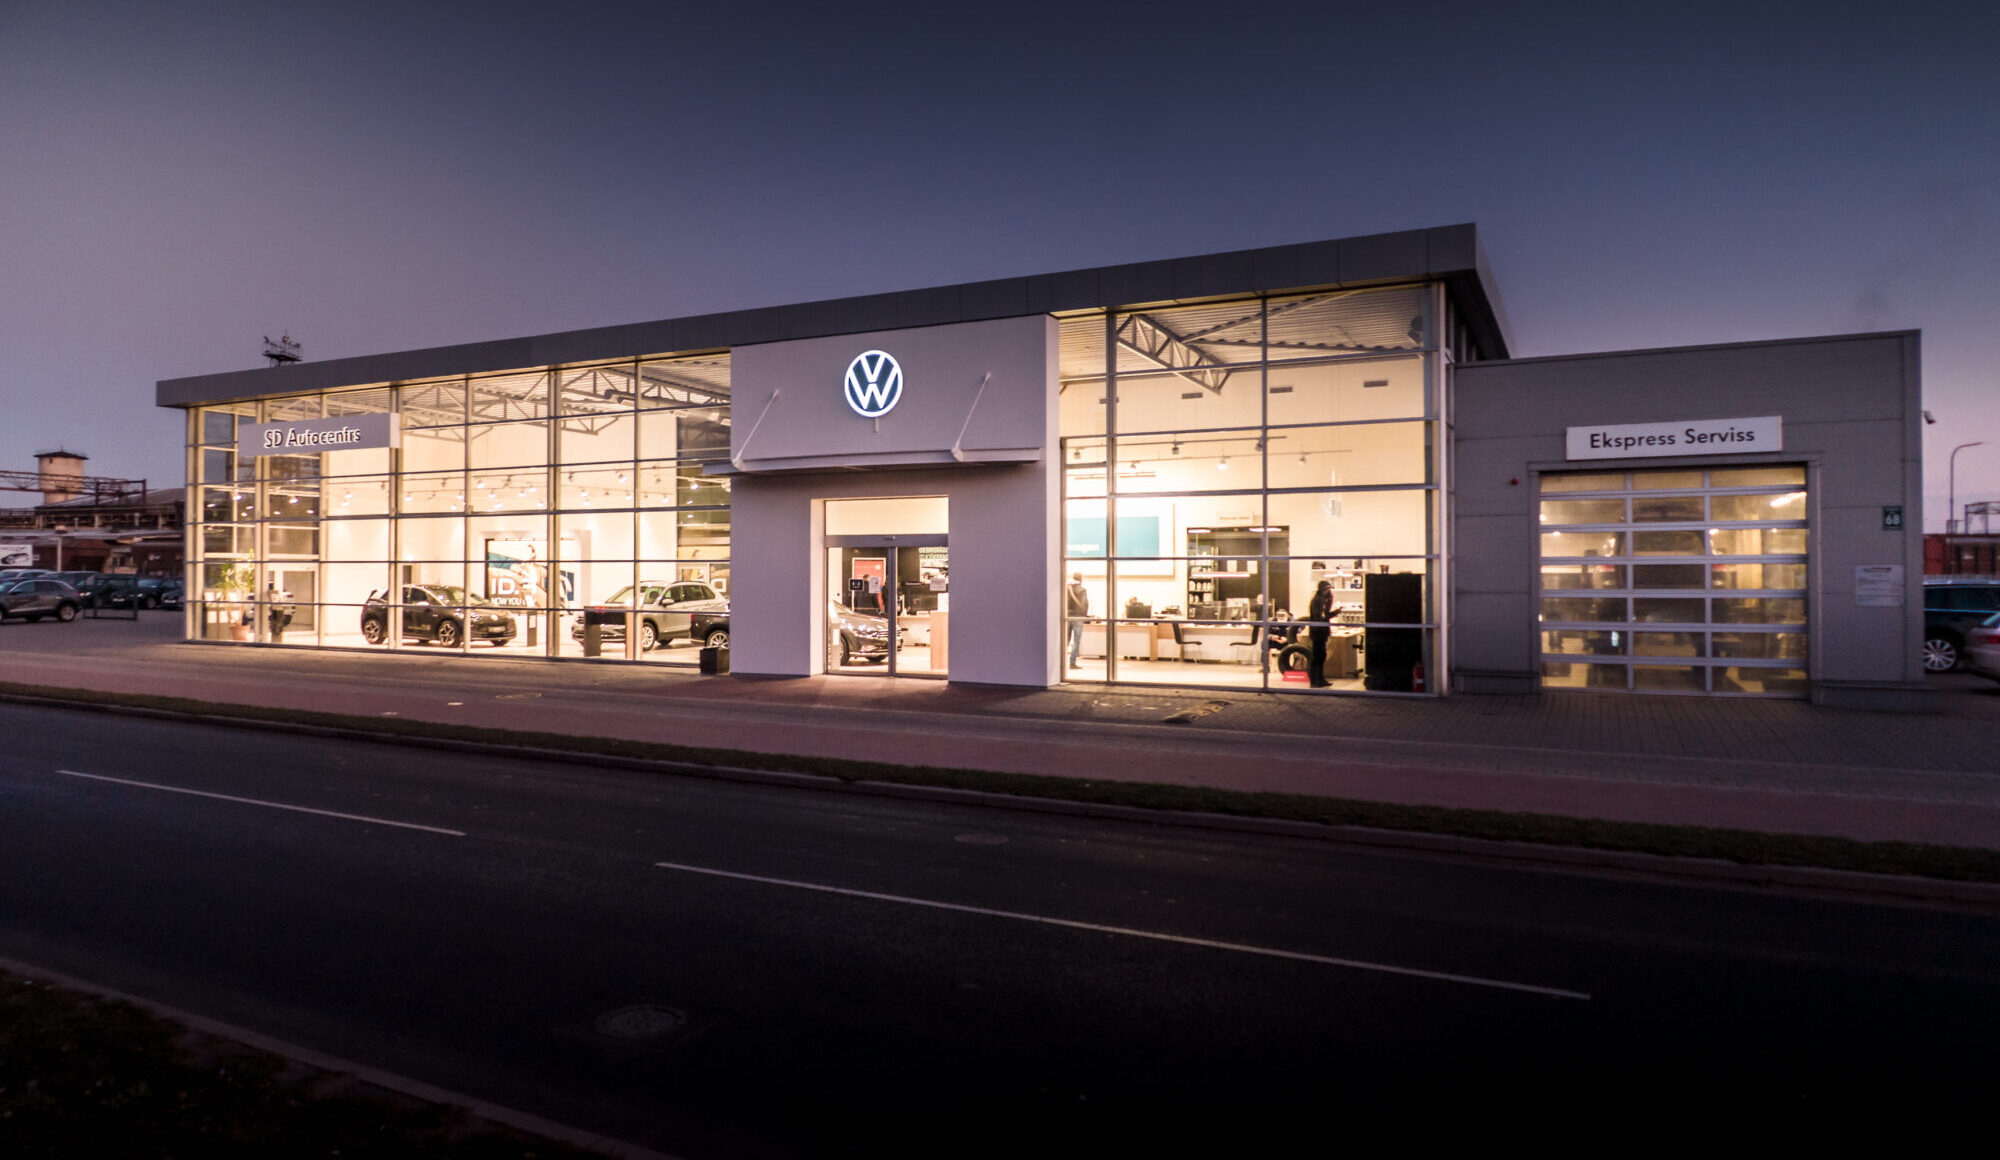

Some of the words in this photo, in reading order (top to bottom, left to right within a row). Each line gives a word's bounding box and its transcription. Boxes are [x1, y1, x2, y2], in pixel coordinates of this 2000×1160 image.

[264, 429, 283, 448] SD
[286, 426, 361, 447] Autocentrs
[1590, 432, 1675, 450] Ekspress
[1685, 427, 1755, 444] Serviss
[1885, 514, 1900, 525] 68
